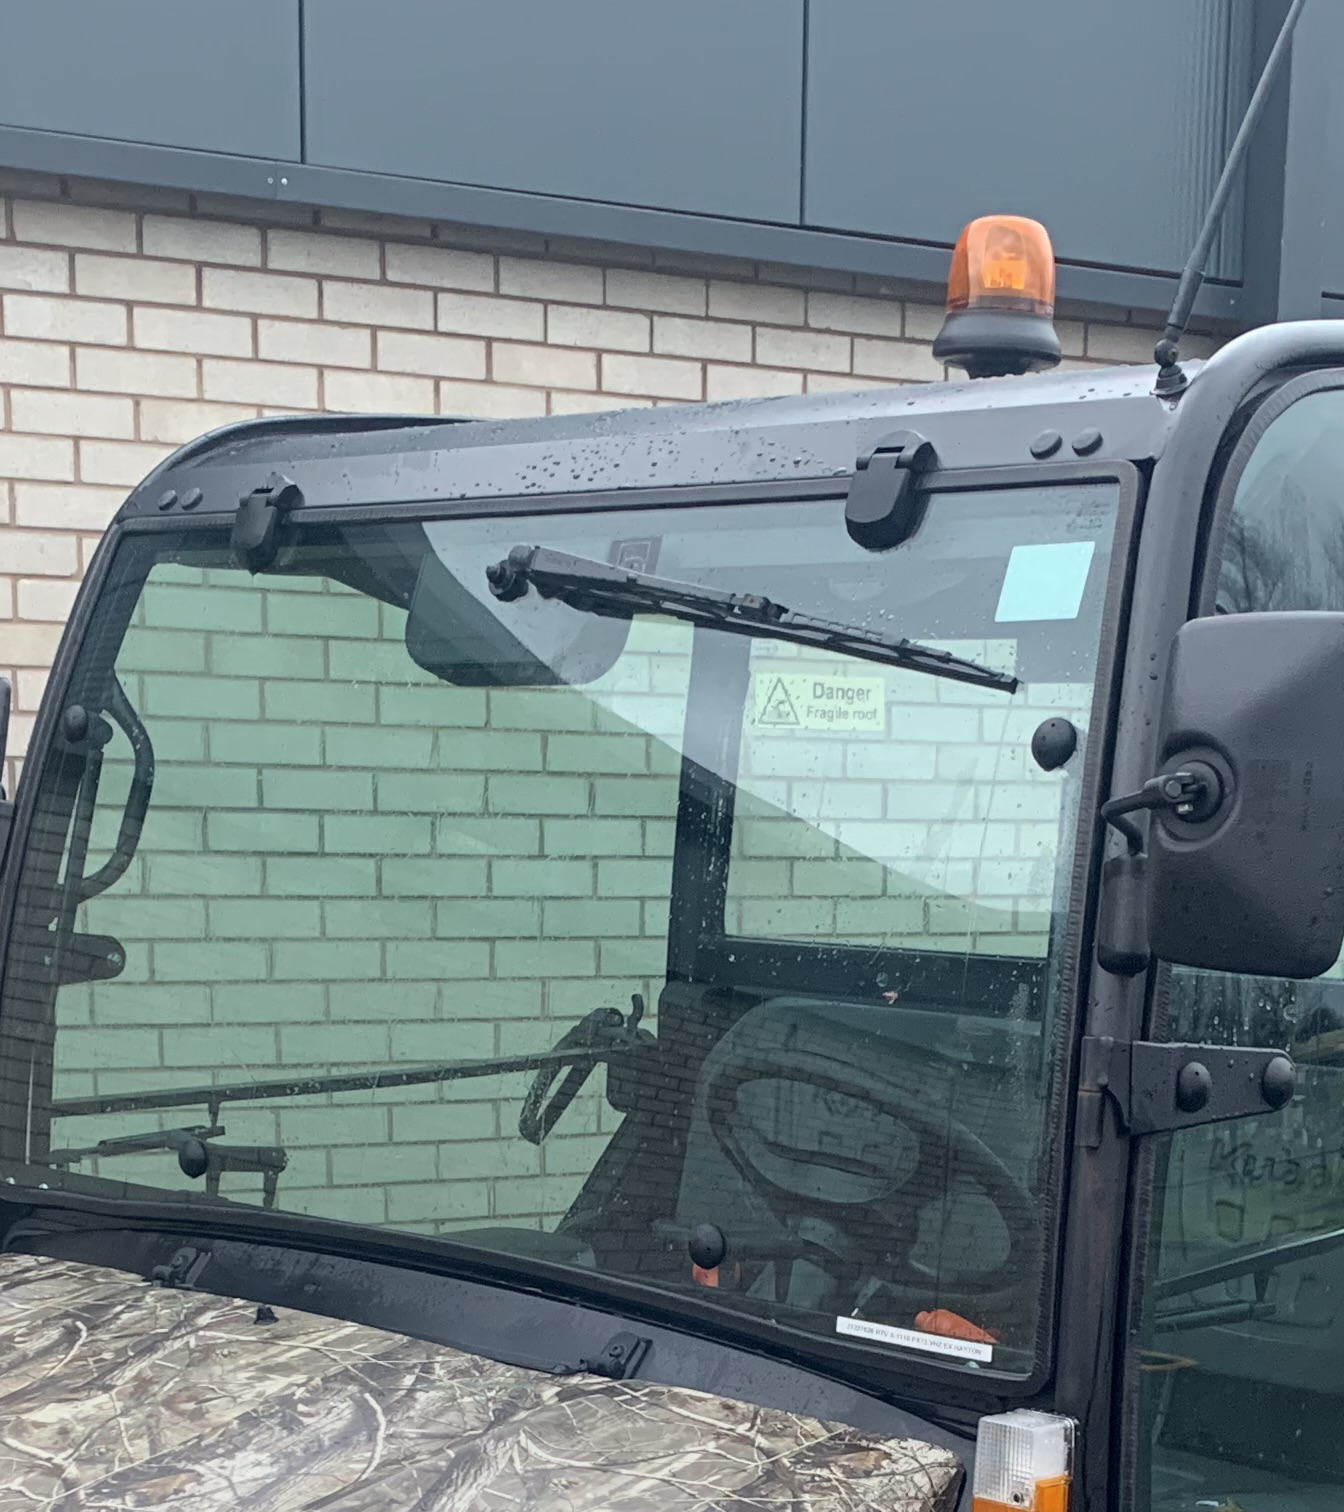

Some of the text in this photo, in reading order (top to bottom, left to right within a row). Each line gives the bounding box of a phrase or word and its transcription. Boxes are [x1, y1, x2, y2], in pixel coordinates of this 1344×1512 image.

[812, 682, 872, 705] Danger
[806, 706, 877, 722] Fragile roof
